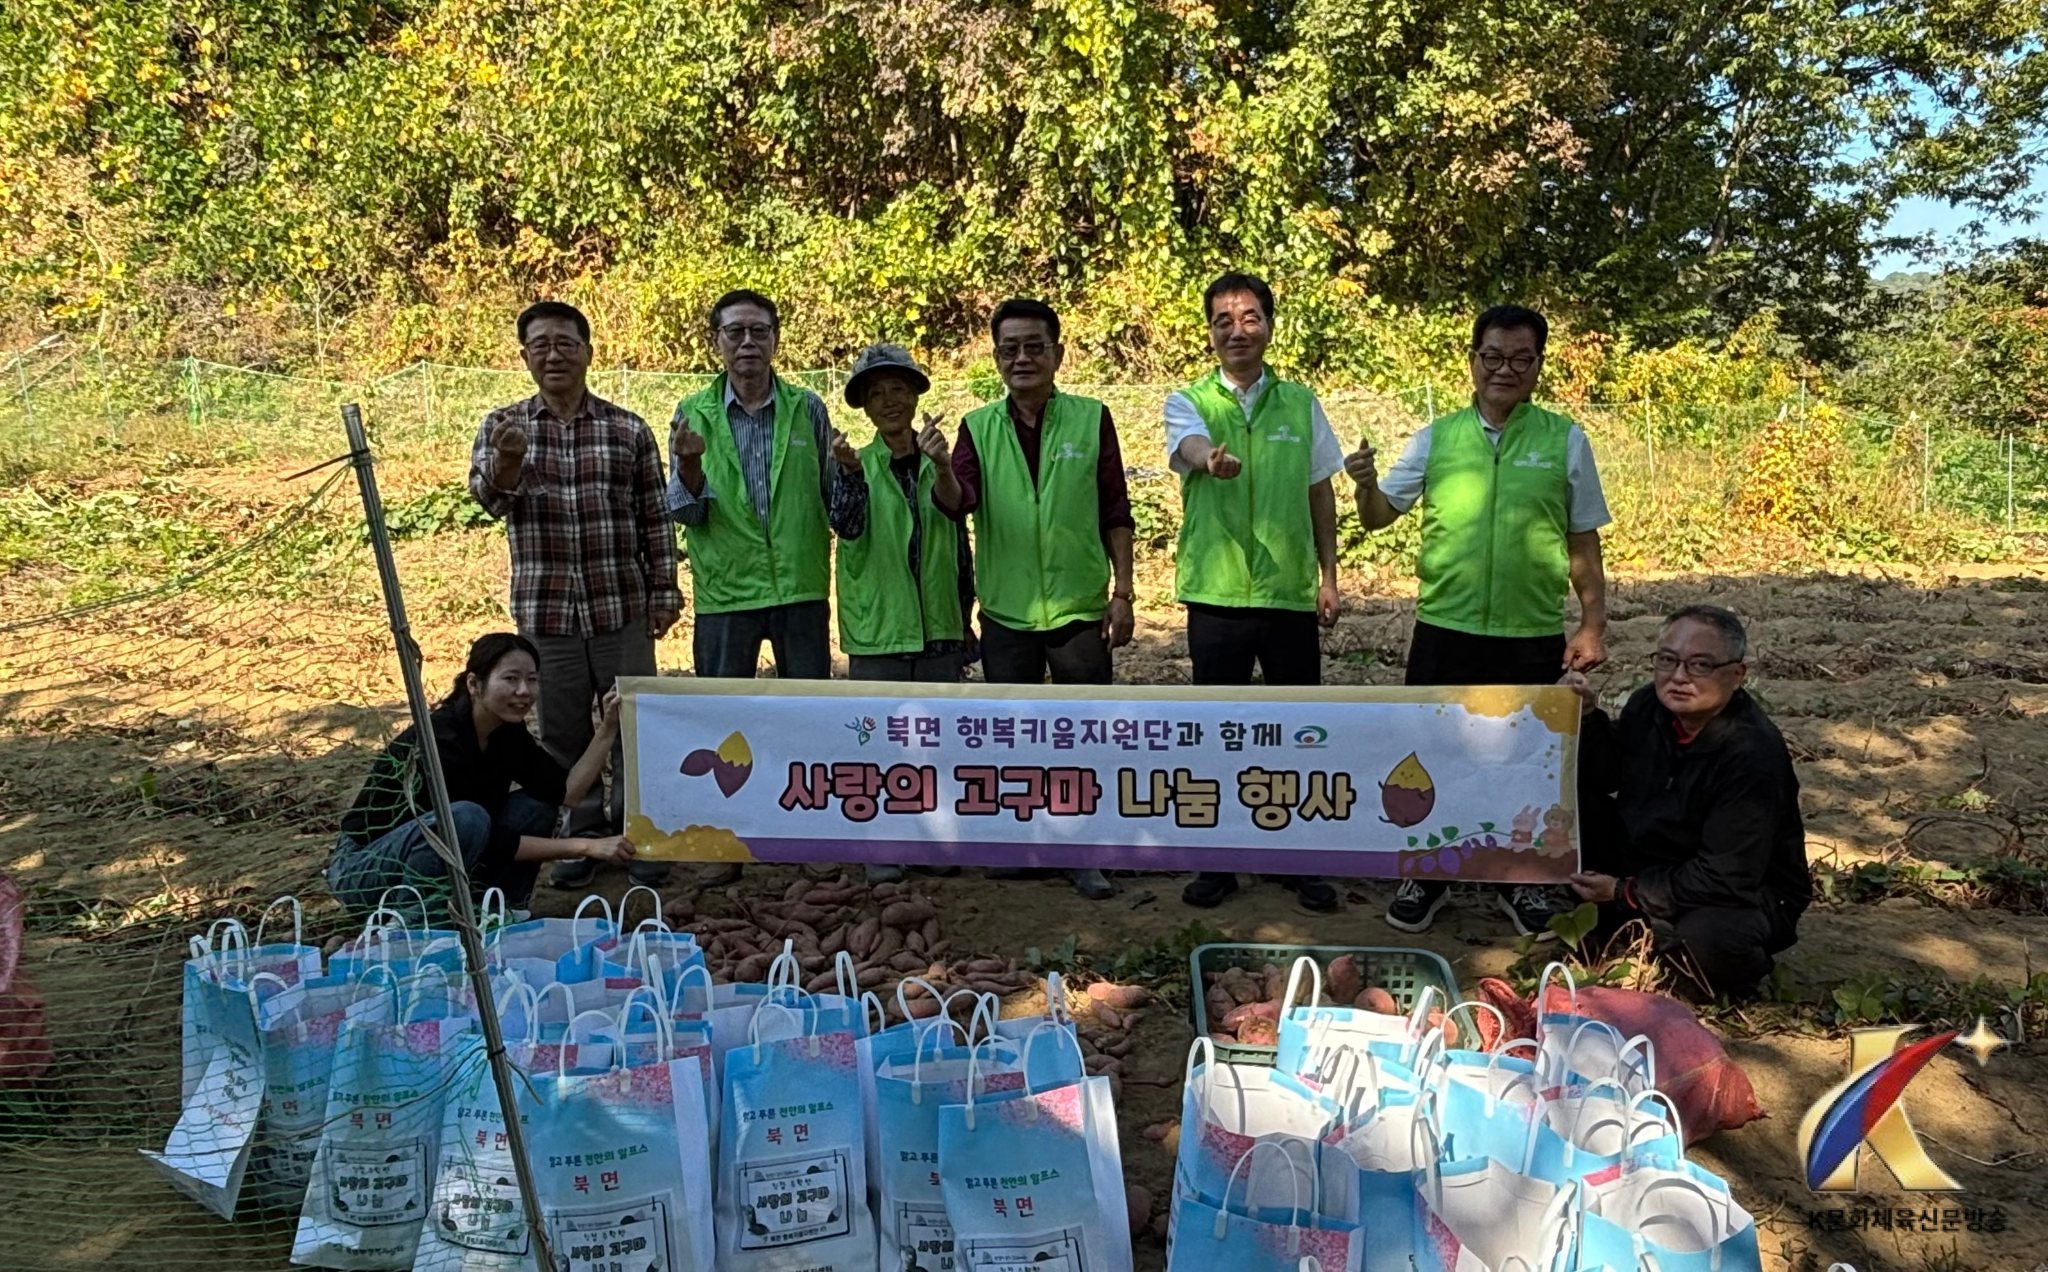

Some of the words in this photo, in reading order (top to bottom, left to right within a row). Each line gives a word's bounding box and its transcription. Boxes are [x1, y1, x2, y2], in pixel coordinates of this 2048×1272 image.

[887, 716, 940, 747] 북면
[957, 716, 1203, 750] 행복키움지원단과
[1219, 721, 1282, 751] 함께
[779, 762, 937, 822] 사랑의
[954, 765, 1102, 821] 고구마
[1118, 768, 1221, 828] 나눔
[1237, 766, 1357, 831] 행사
[617, 1143, 649, 1160] 알프스
[1030, 1168, 1060, 1186] 알프스
[796, 1186, 830, 1204] 고구마
[609, 1236, 647, 1257] 고구마
